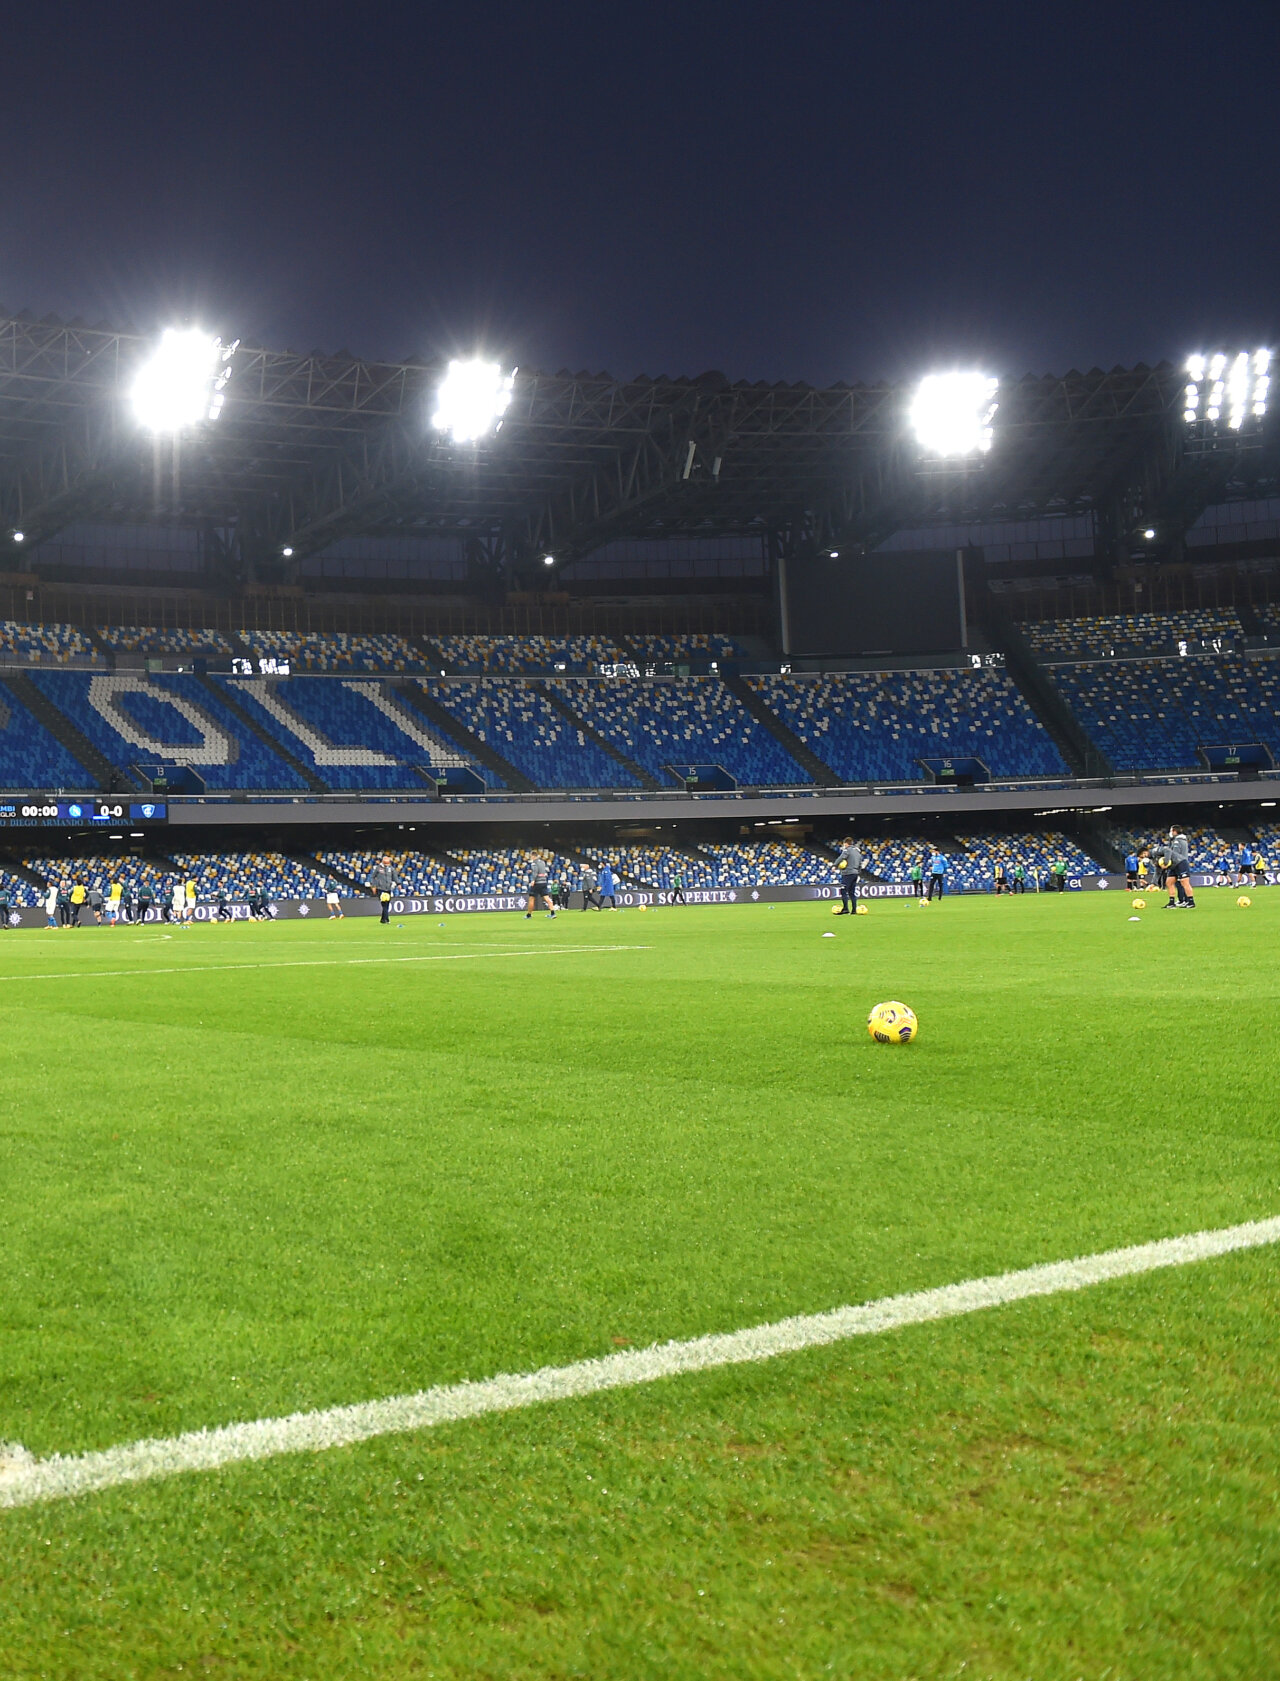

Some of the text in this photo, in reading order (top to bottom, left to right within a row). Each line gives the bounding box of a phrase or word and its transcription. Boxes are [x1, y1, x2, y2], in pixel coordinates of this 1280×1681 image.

[1228, 747, 1237, 756] 17
[943, 760, 952, 768] 16
[156, 767, 165, 776] 13
[689, 767, 697, 775] 15
[21, 805, 58, 817] 00:00
[100, 805, 123, 817] 0-0
[410, 900, 429, 912] DI
[435, 896, 516, 912] SCOPERTE
[639, 893, 653, 905] DI
